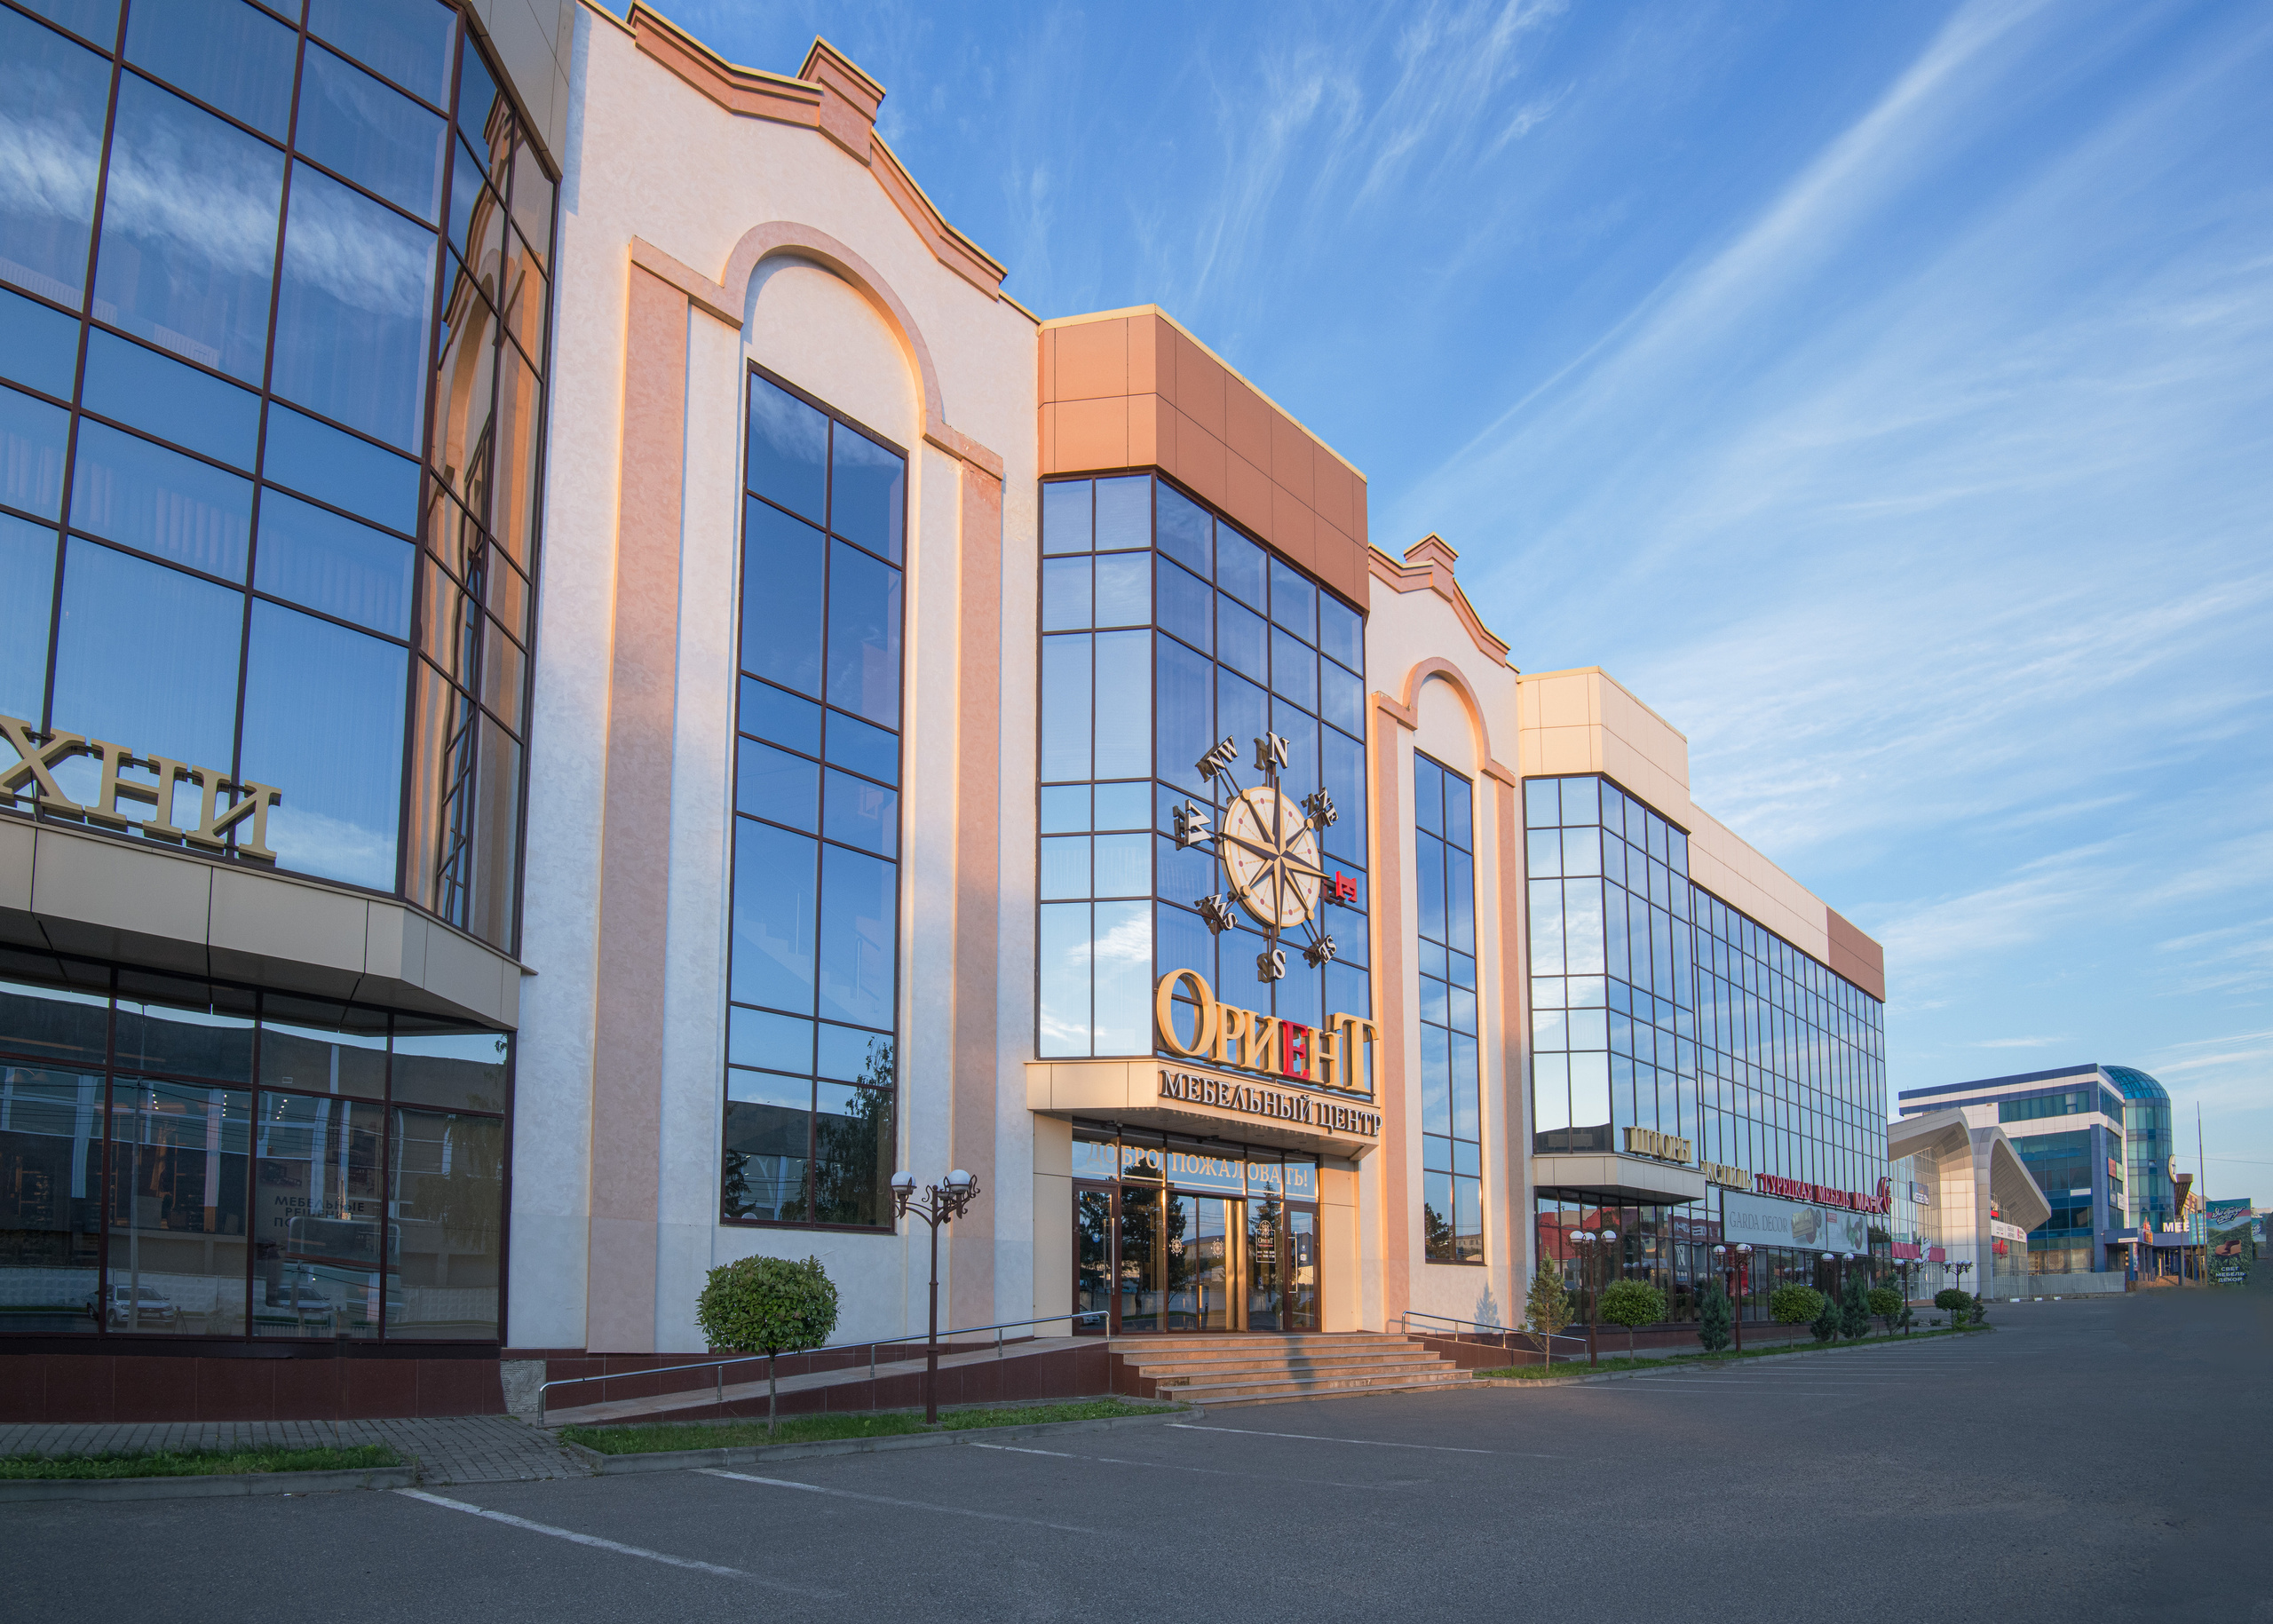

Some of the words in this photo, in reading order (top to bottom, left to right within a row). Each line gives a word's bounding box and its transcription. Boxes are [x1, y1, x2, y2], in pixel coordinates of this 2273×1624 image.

[1206, 735, 1239, 777] NW
[1266, 732, 1290, 770] N
[0, 715, 282, 863] ХНИ
[1335, 870, 1358, 903] E
[1271, 948, 1287, 980] S
[1160, 1069, 1313, 1125] МЕБЕЛЬНЫЙ
[1316, 1102, 1383, 1137] ЦЕНТР
[1087, 1140, 1160, 1169] ДОБРО
[1171, 1151, 1308, 1188] ПОЖАЛОВАТЬ!
[1623, 1126, 1693, 1164] ШТОРЫ
[1755, 1173, 1813, 1200] ТУРЕЦКАЯ
[1816, 1184, 1850, 1208] МЕБЕЛЬ
[1730, 1211, 1760, 1231] GARDA
[1762, 1215, 1788, 1233] DECOR
